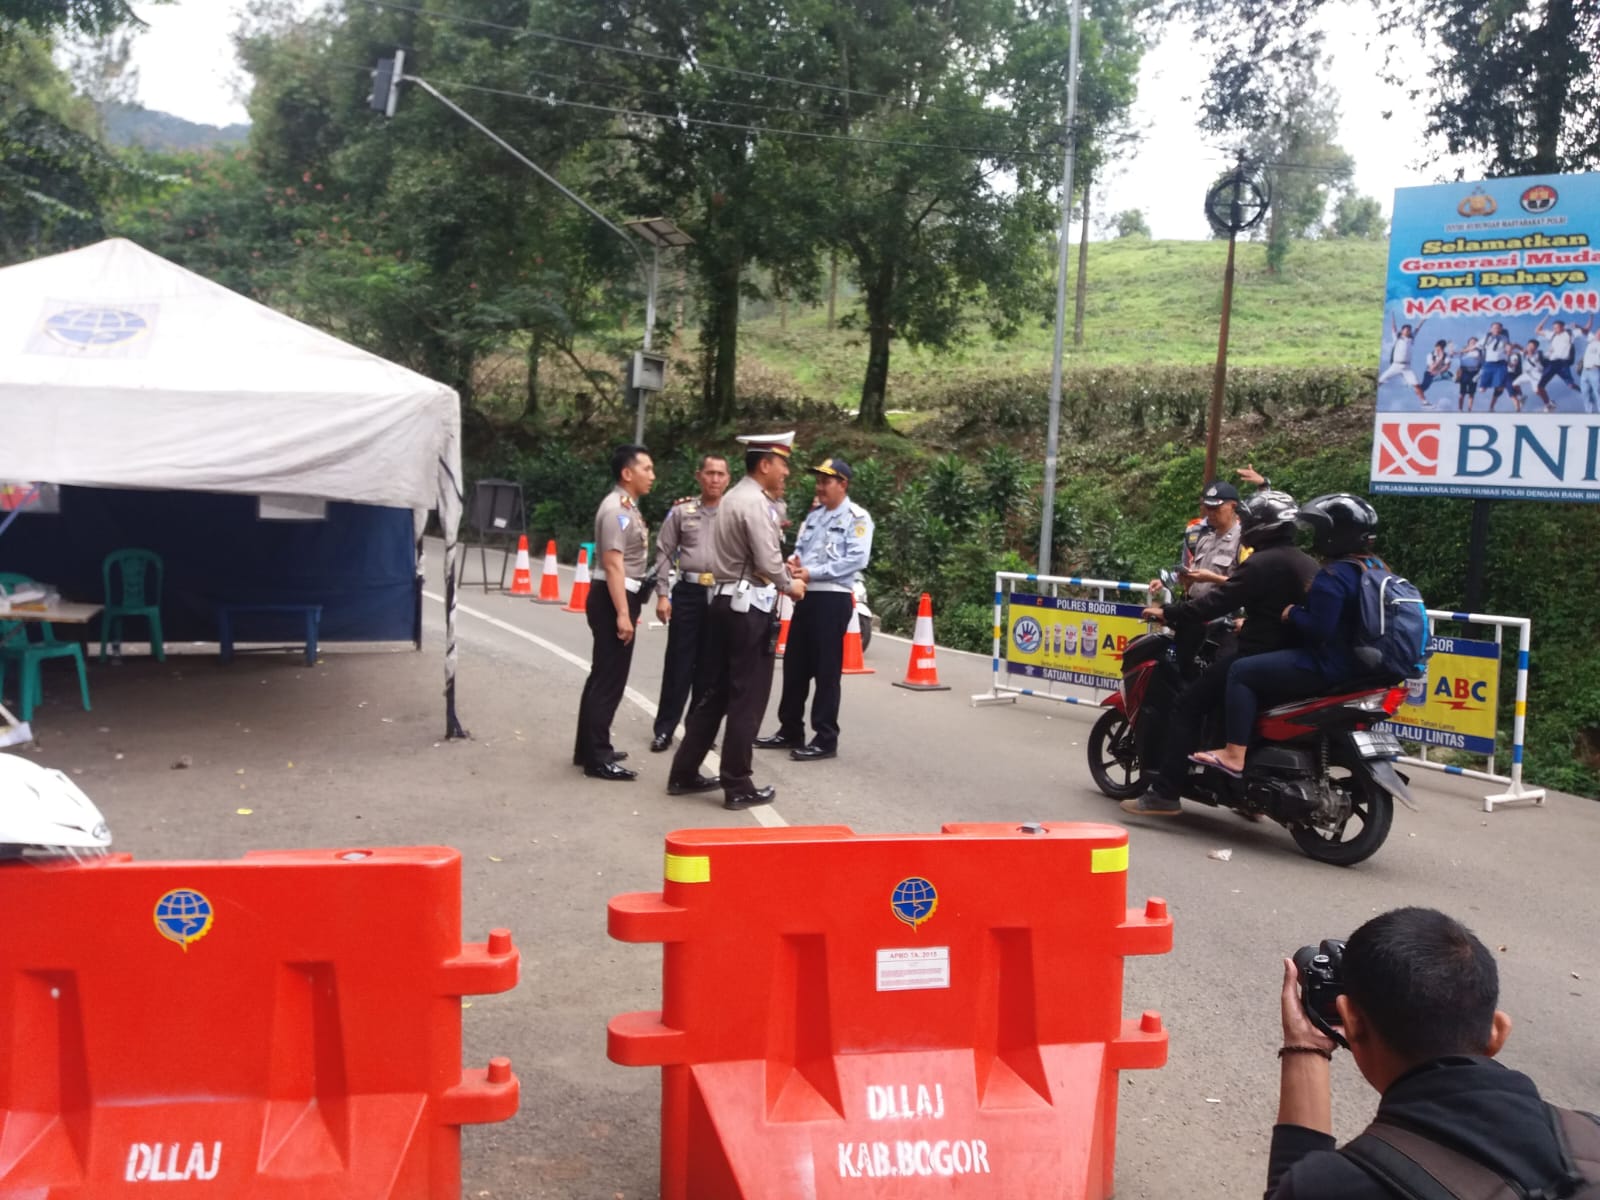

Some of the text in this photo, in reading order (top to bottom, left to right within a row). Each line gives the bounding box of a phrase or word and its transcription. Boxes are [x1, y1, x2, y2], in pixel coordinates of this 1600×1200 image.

[1422, 233, 1588, 254] Selamatkan
[1403, 254, 1518, 272] Generasi
[1418, 270, 1587, 289] Dari Bahaya
[1406, 294, 1557, 315] NARKOBA
[1454, 423, 1600, 482] BNI
[1375, 484, 1418, 493] KERJASAMA
[1420, 486, 1449, 494] ANTARA
[1450, 487, 1472, 495] DIVISI
[1501, 489, 1524, 497] POLRI
[1526, 490, 1560, 498] DENGAN
[1561, 491, 1584, 499] BANK
[1056, 599, 1117, 615] POLRES BOGOR
[1102, 633, 1128, 651] AB
[1431, 638, 1454, 652] GOR
[1042, 668, 1072, 681] SATUAN
[1074, 673, 1094, 685] LALU
[1434, 676, 1487, 702] ABC
[1395, 725, 1422, 741] LALU
[1426, 730, 1465, 748] LINTAS
[866, 1083, 945, 1120] DLLAJ
[125, 1140, 222, 1182] DLLAJ
